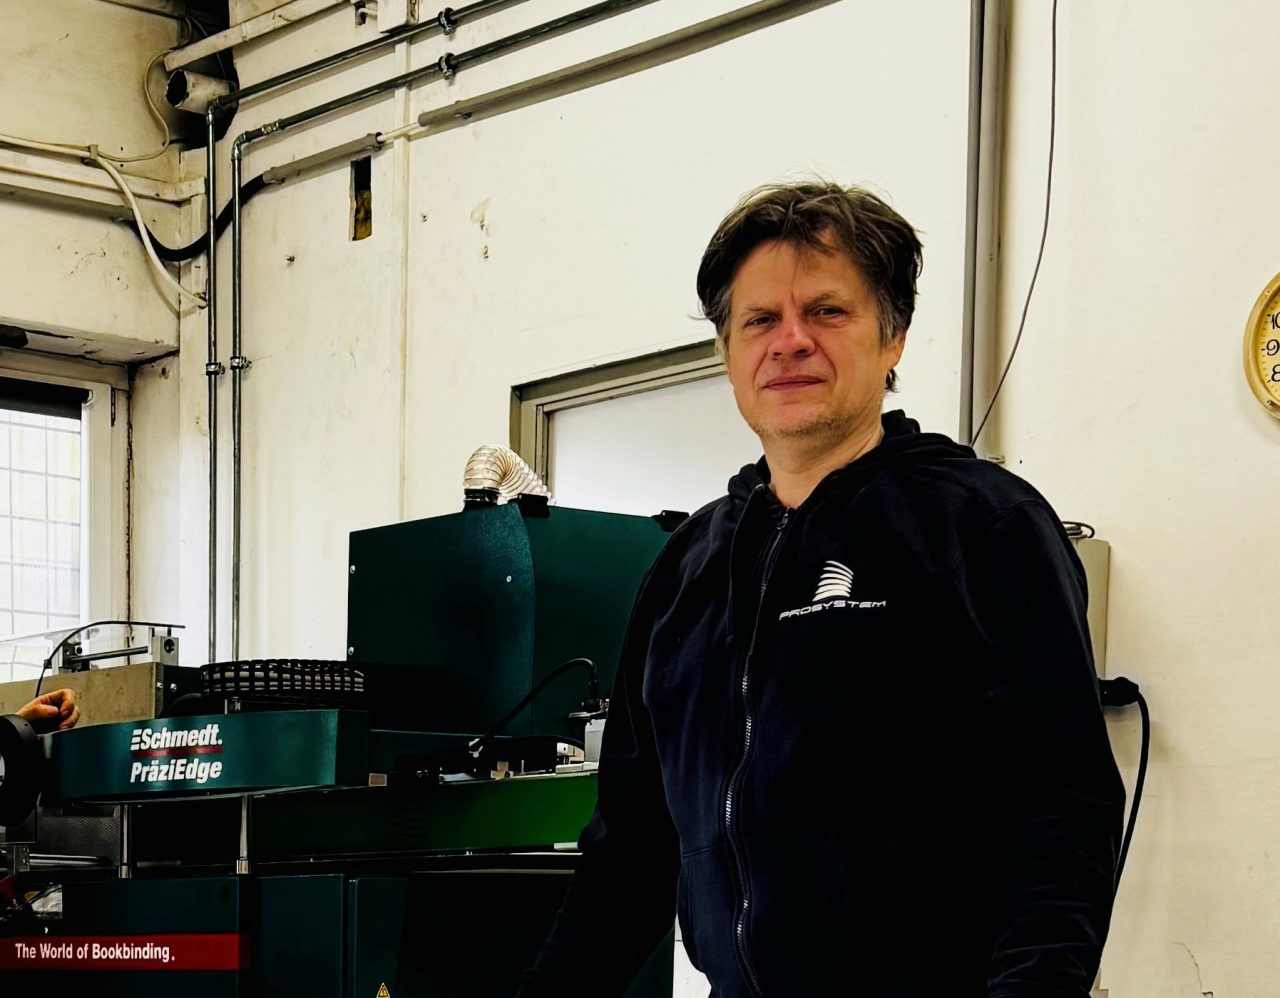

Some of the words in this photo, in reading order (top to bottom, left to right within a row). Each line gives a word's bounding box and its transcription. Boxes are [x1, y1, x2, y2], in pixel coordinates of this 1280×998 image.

[1266, 339, 1279, 356] 9
[1271, 364, 1280, 382] 8
[778, 600, 887, 621] PROSYSTEM
[130, 758, 223, 784] PräziEdge
[15, 943, 37, 959] The
[40, 943, 73, 959] World
[77, 943, 90, 959] of
[92, 943, 176, 963] Bookbinding.
